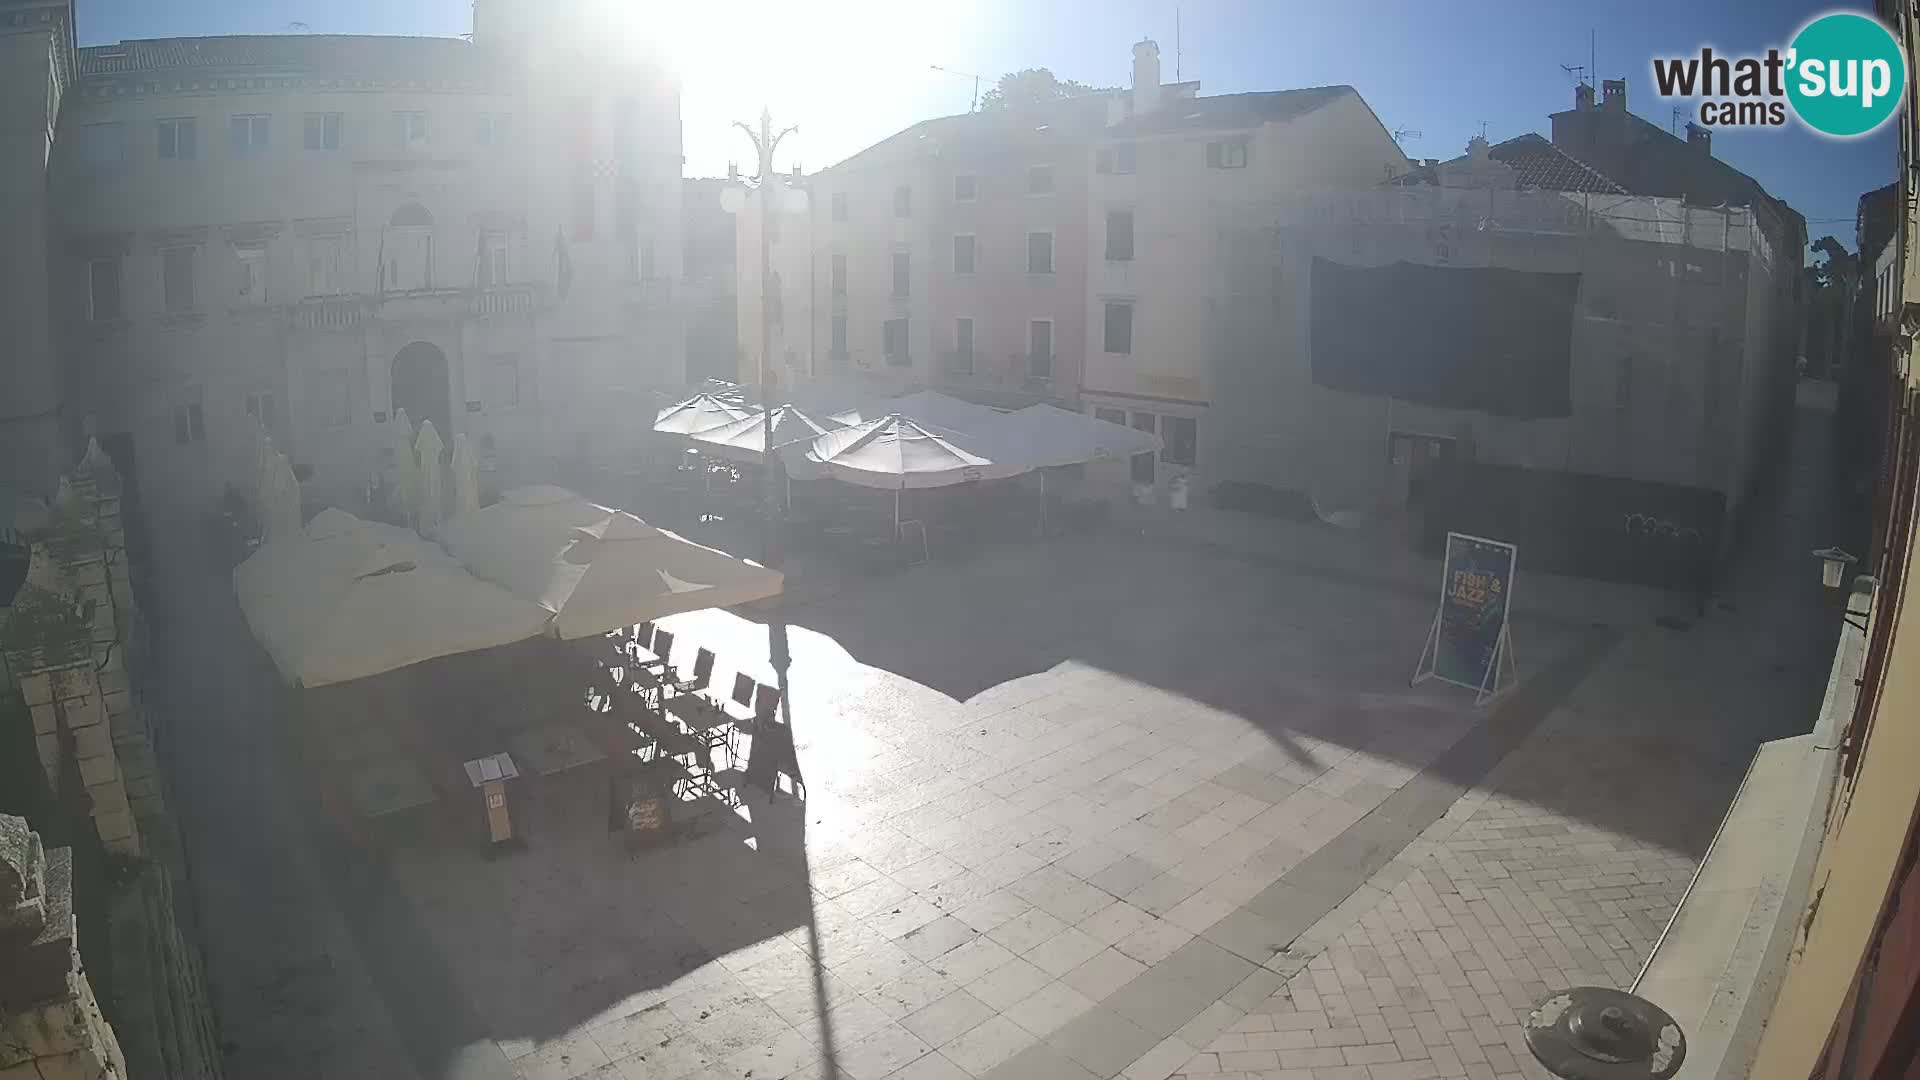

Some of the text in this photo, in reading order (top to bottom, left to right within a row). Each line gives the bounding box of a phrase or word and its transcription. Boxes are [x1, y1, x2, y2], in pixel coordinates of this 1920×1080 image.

[1455, 570, 1502, 593] FISH &
[1447, 585, 1486, 603] JAZZ
